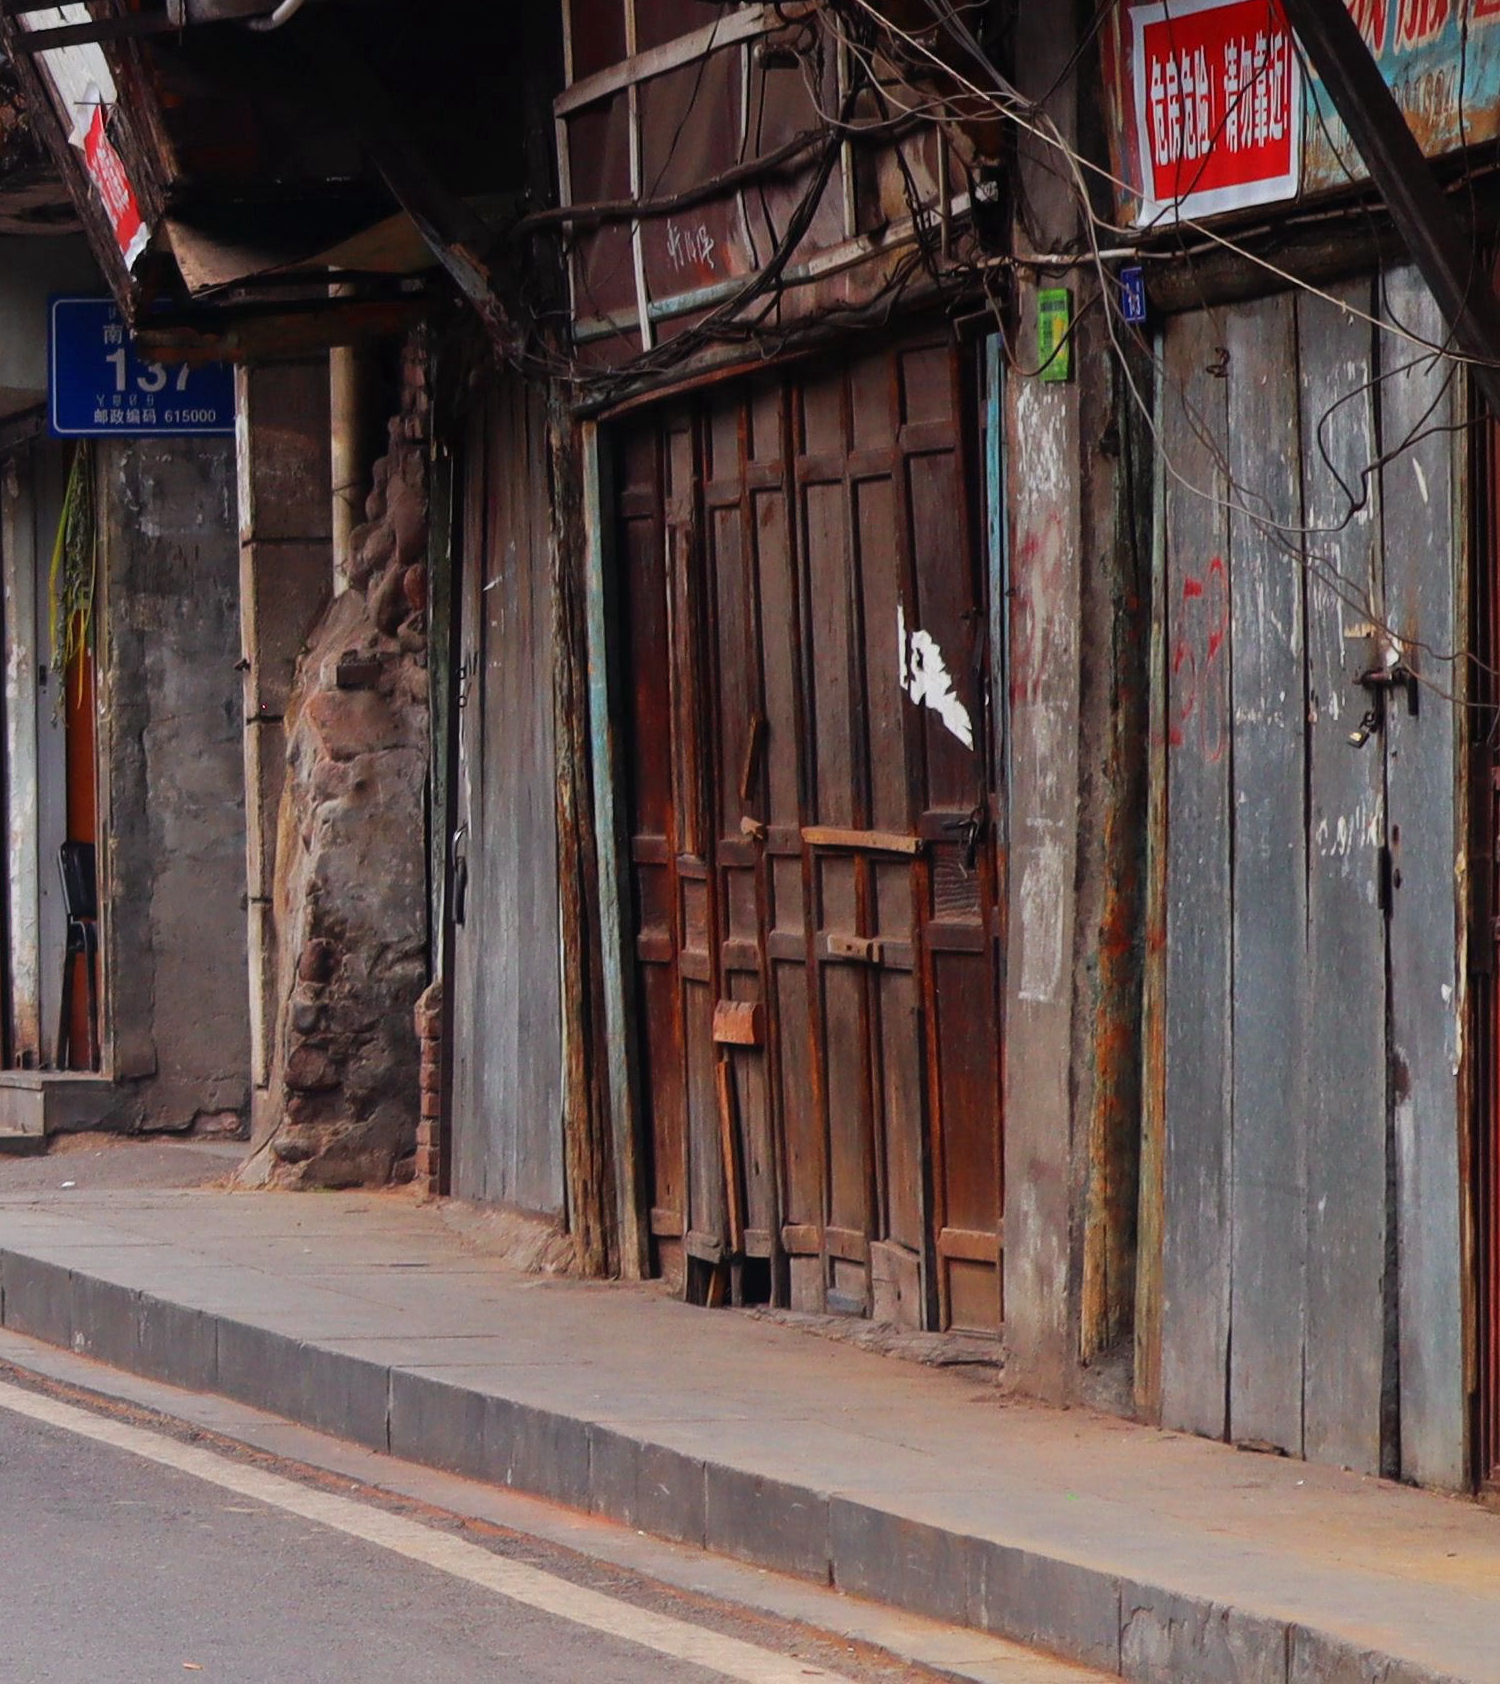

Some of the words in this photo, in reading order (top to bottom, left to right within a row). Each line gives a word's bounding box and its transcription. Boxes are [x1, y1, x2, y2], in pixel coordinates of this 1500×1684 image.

[1223, 29, 1291, 156] 请勿靠近！
[93, 408, 157, 425] 邮政编码
[164, 409, 217, 423] 615000
